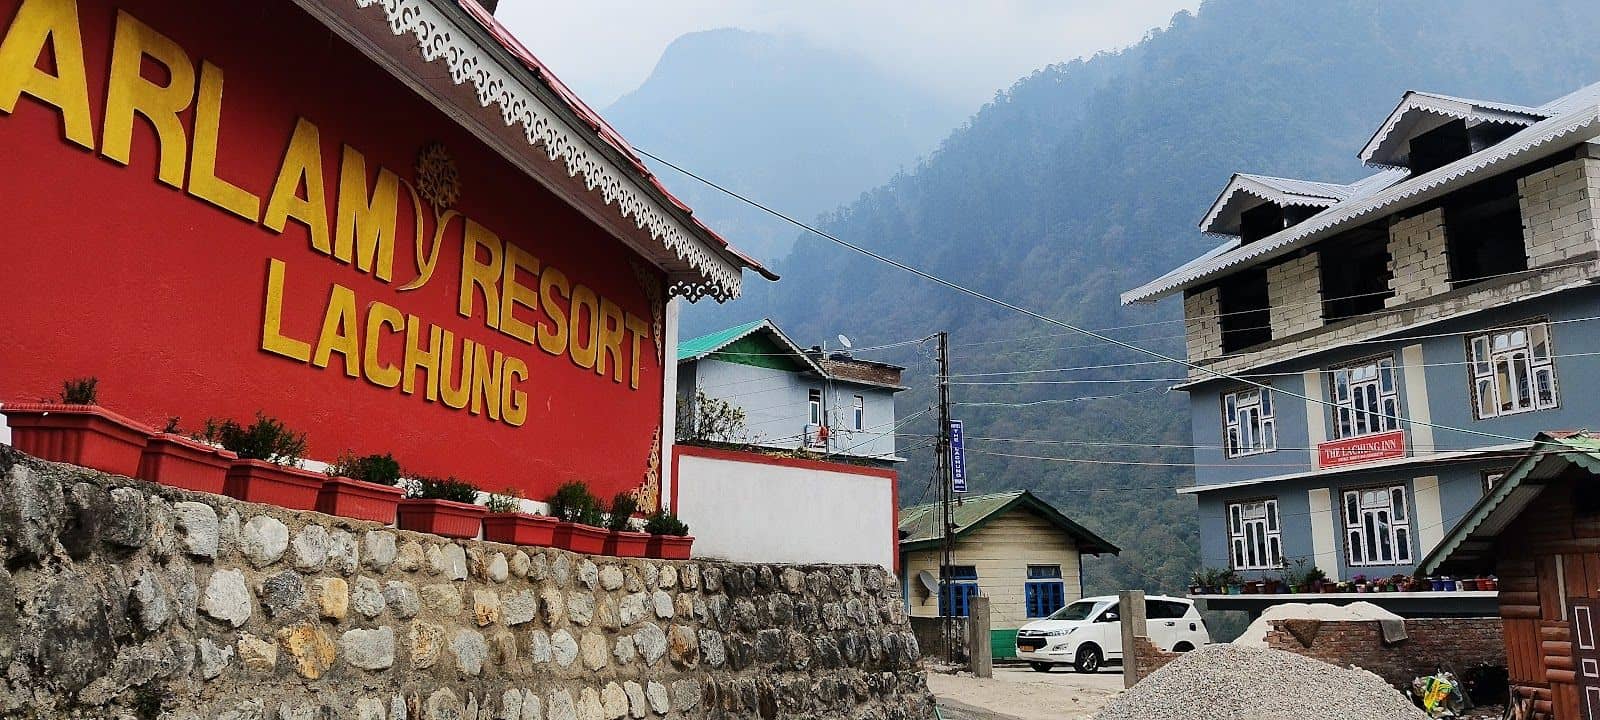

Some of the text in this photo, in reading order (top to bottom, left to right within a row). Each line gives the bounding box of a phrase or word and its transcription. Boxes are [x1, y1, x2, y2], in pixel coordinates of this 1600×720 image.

[262, 258, 528, 426] LACHUNG
[459, 216, 649, 390] RESORT
[1325, 447, 1341, 459] THE
[1342, 441, 1380, 457] LACHUNG
[1381, 439, 1397, 451] INN
